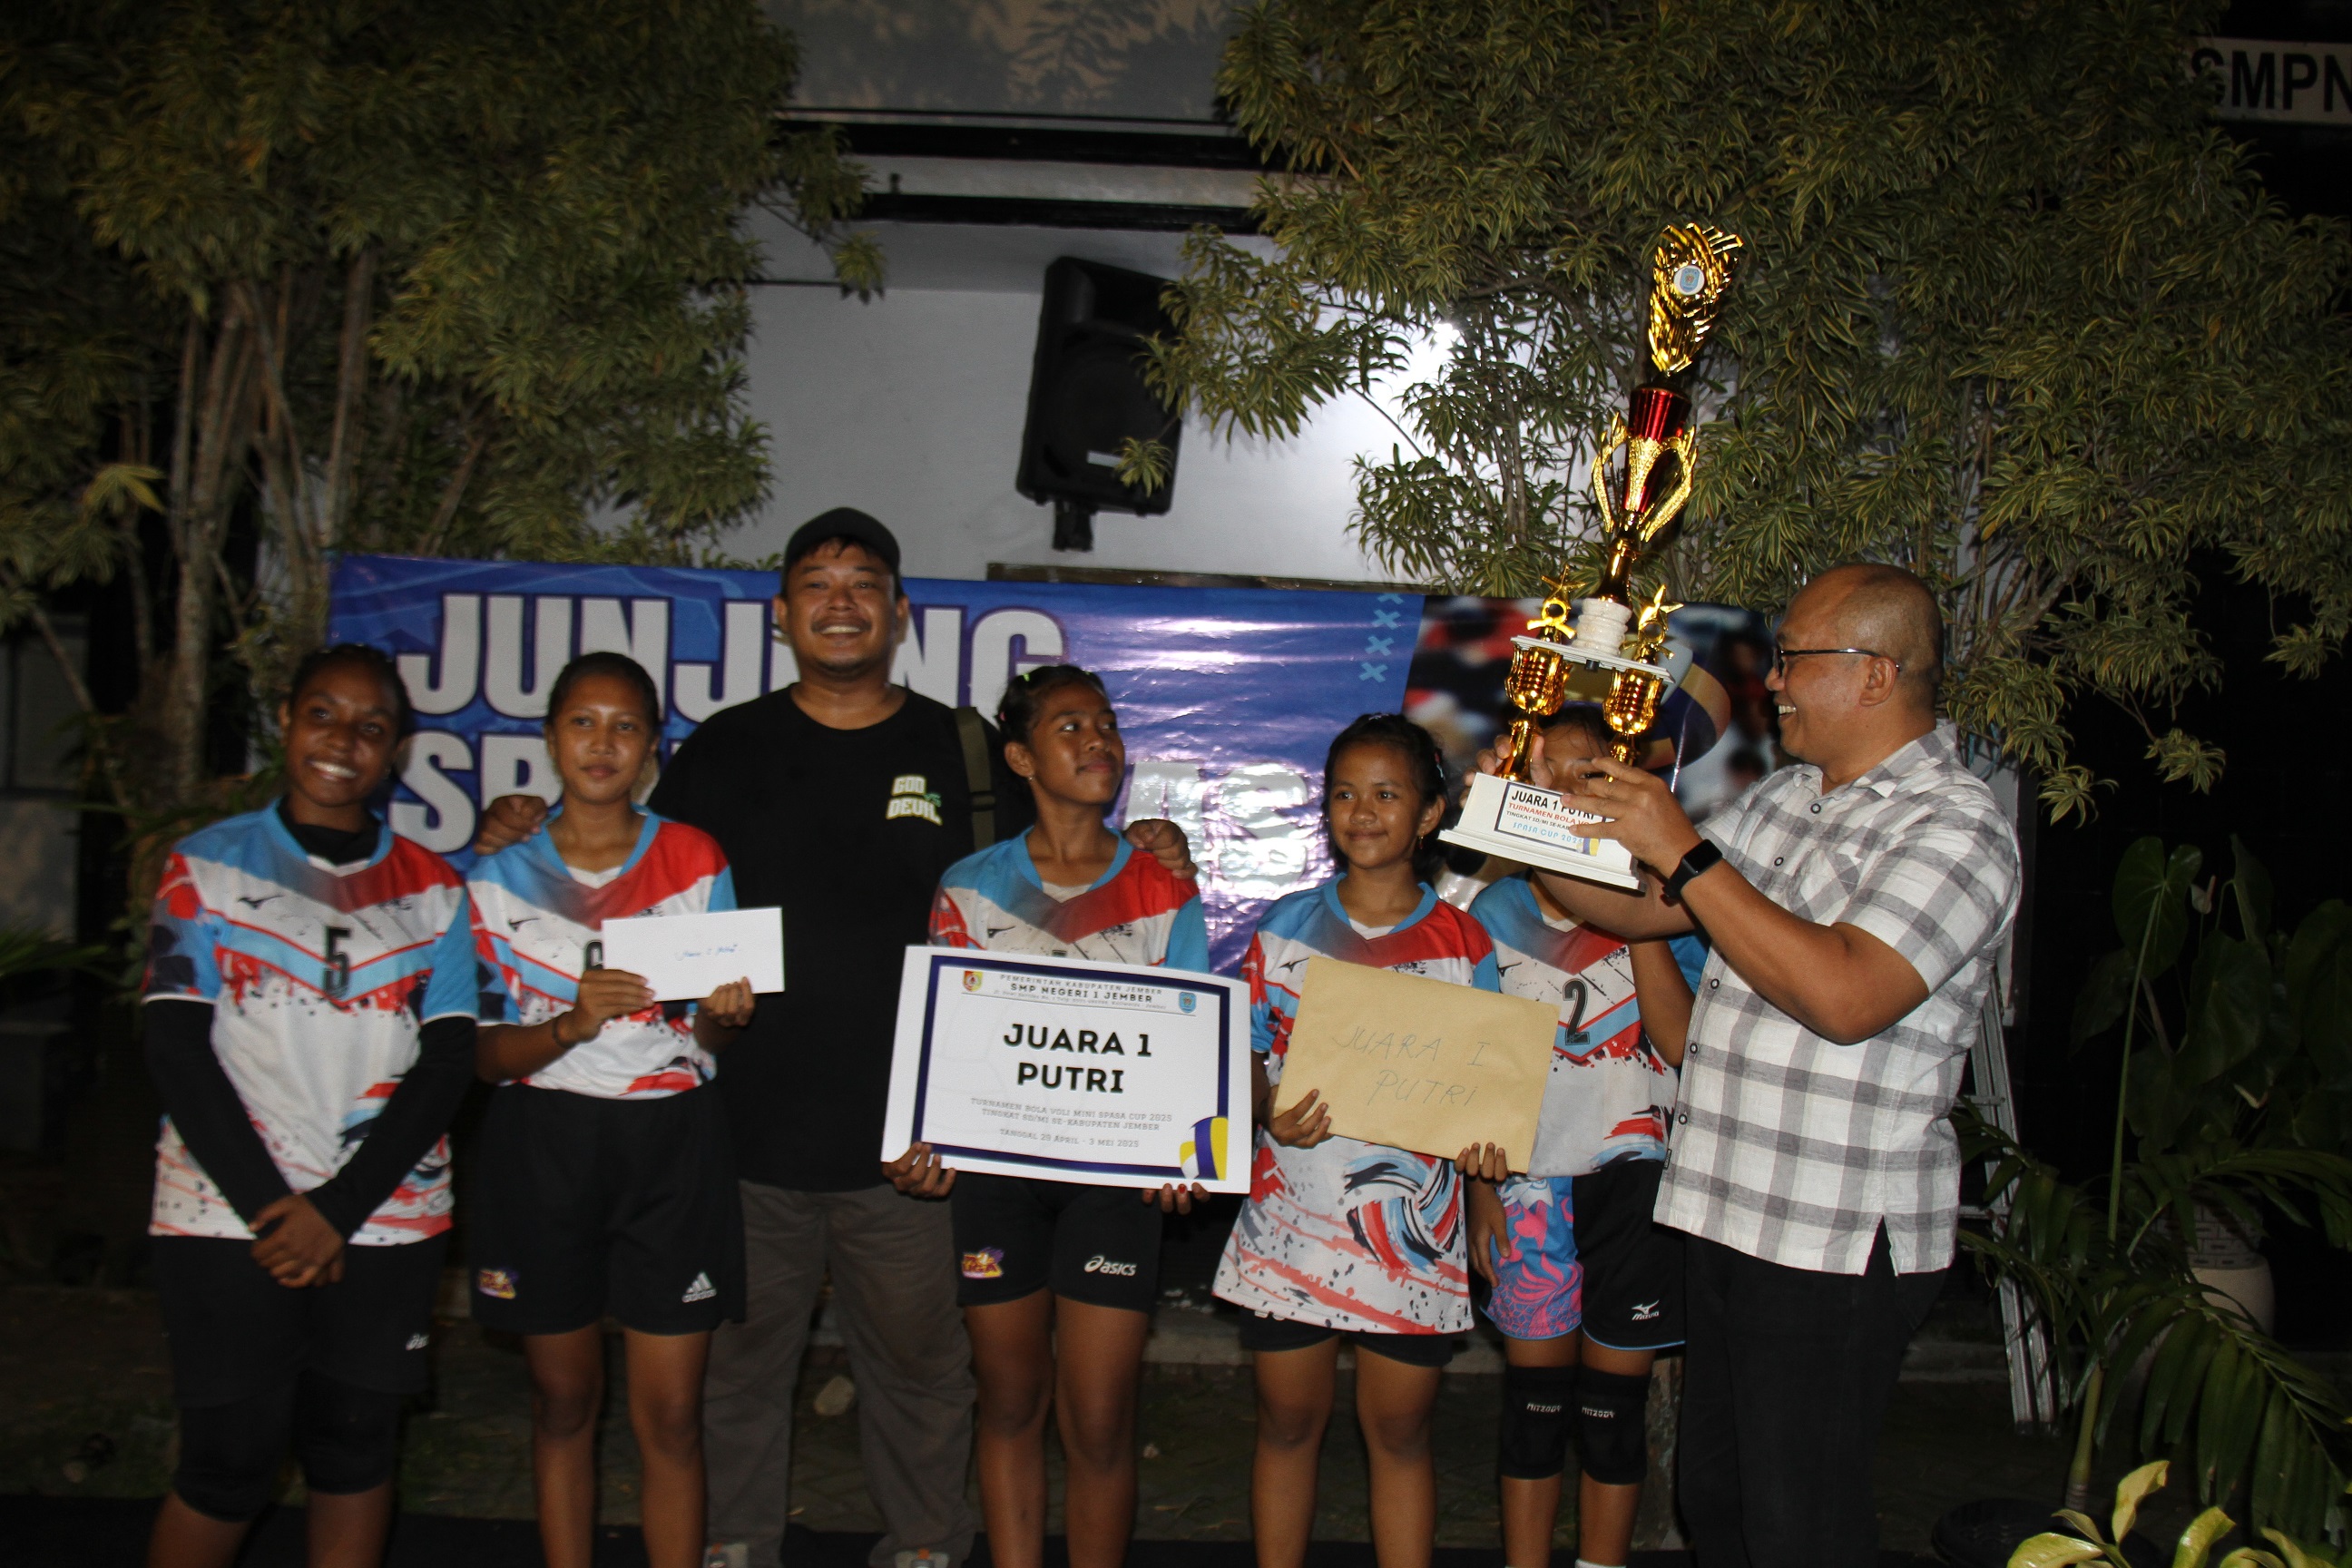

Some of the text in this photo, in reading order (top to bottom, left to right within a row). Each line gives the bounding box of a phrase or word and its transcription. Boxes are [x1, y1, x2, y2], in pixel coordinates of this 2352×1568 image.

[397, 593, 1063, 731] JUNJNG
[1511, 790, 1548, 809] JUARA
[1553, 800, 1558, 811] 1
[1506, 810, 1532, 821] TINGKAT
[1508, 802, 1576, 825] TURNAMEN BOLA
[1541, 829, 1559, 838] CUP
[323, 926, 351, 998] 5
[1000, 975, 1161, 995] PEMERINTAH KABUPATEN JEMBER
[1011, 983, 1036, 993] SMP
[1042, 986, 1088, 998] NEGERI
[1103, 992, 1152, 1003] JEMBER
[1563, 978, 1590, 1045] 2
[1003, 1024, 1152, 1057] JUARA 1
[1331, 1026, 1442, 1062] JUARA
[1017, 1062, 1124, 1093] PUTRI
[970, 1097, 1022, 1111] TURNAMEN
[1024, 1105, 1047, 1114] BOLA
[1050, 1108, 1070, 1116] VOLI
[1073, 1110, 1096, 1118] MINI
[1098, 1112, 1125, 1120] SPASA
[1128, 1112, 1147, 1121] CUP
[982, 1108, 1020, 1120] TINGKAT
[1122, 1122, 1160, 1131] JEMBER
[1000, 1128, 1039, 1140] TANGGAL
[1054, 1135, 1080, 1144] APRIL
[1097, 1139, 1115, 1147] MEI
